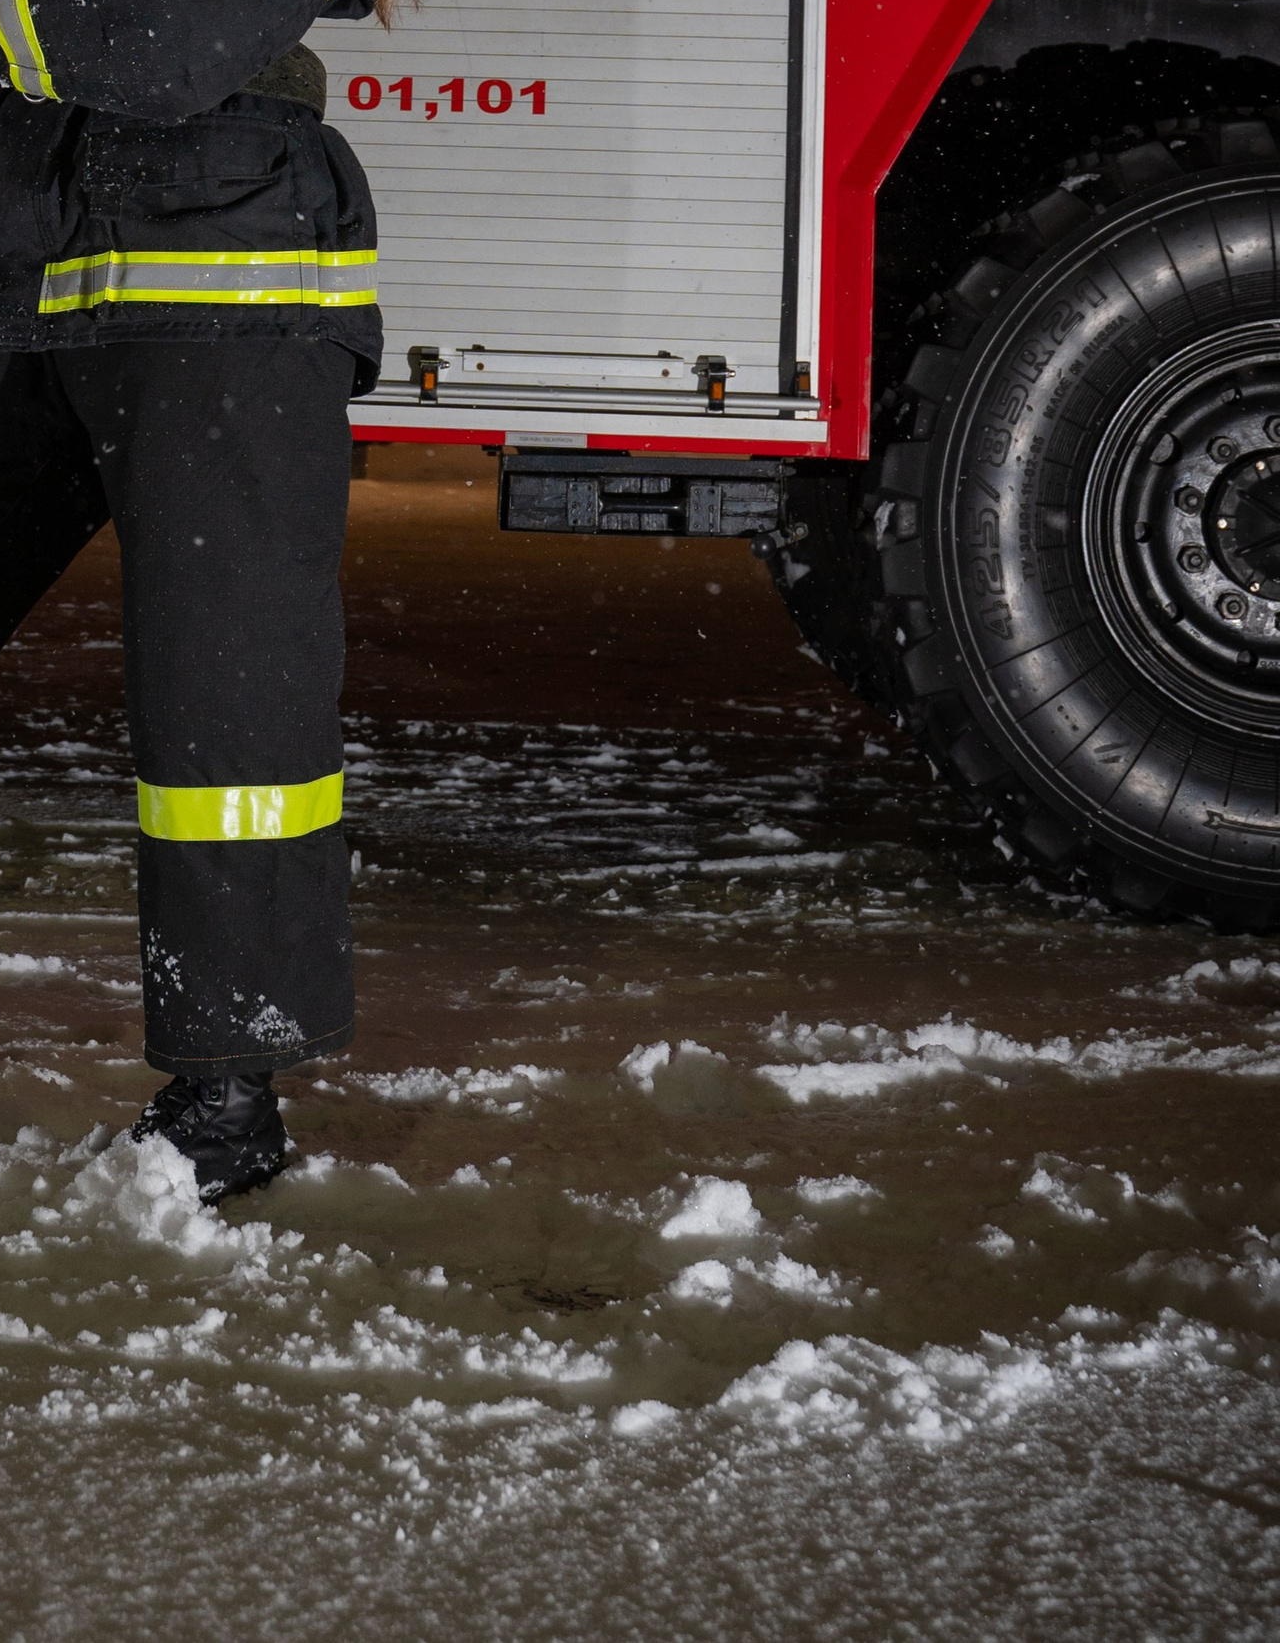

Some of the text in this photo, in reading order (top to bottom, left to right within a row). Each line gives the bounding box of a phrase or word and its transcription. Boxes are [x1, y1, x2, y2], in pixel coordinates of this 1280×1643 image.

[347, 75, 547, 121] 01,101
[1043, 314, 1130, 420] MADE IN RUSSIA
